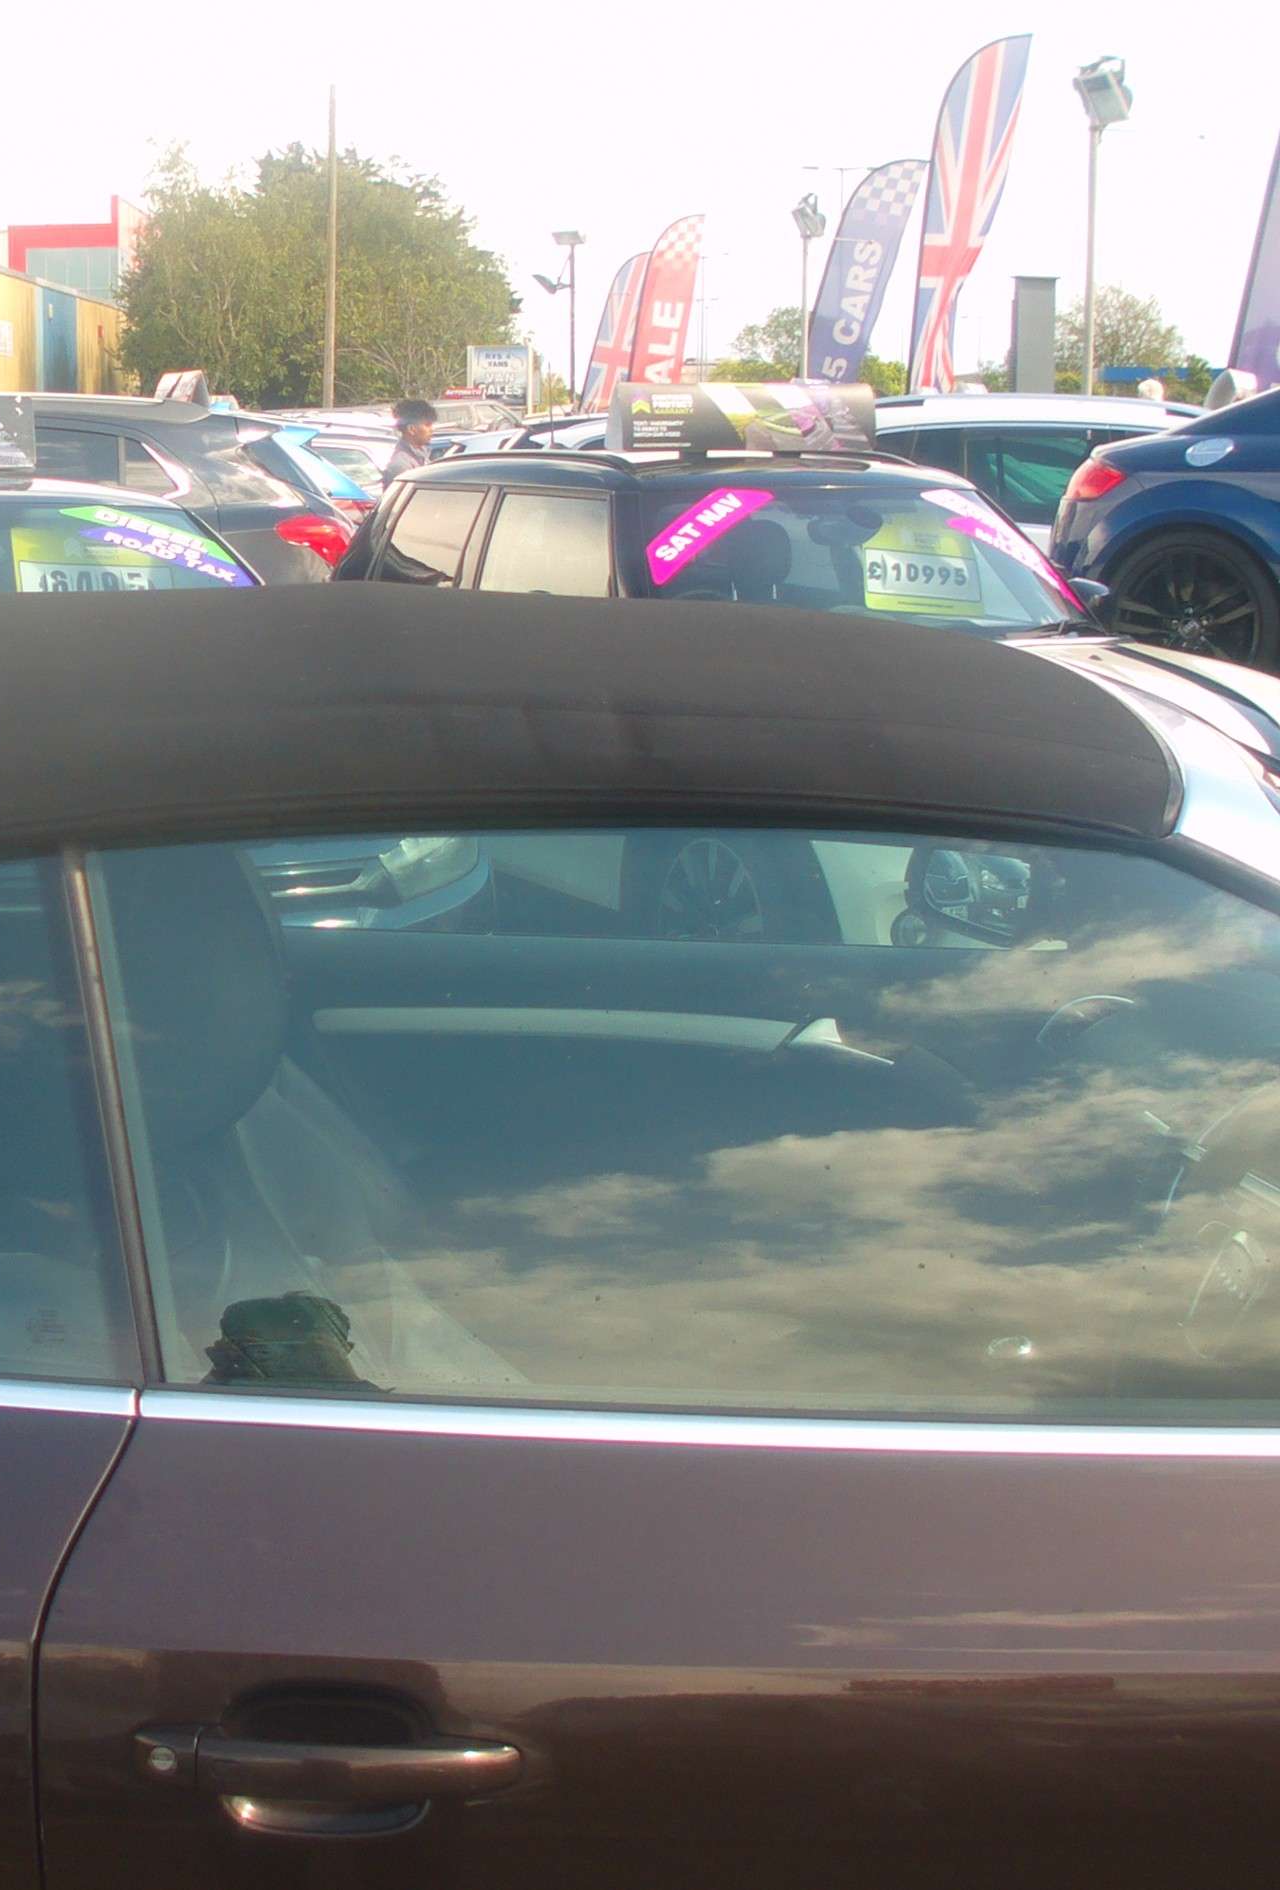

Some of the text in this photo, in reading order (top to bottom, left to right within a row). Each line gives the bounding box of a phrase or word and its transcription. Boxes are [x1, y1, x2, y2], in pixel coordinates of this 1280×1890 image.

[832, 239, 883, 345] CARS
[94, 509, 209, 553] DIESEL
[103, 531, 177, 560] ROAD
[185, 556, 236, 582] TAX
[655, 492, 743, 561] SAT NAV
